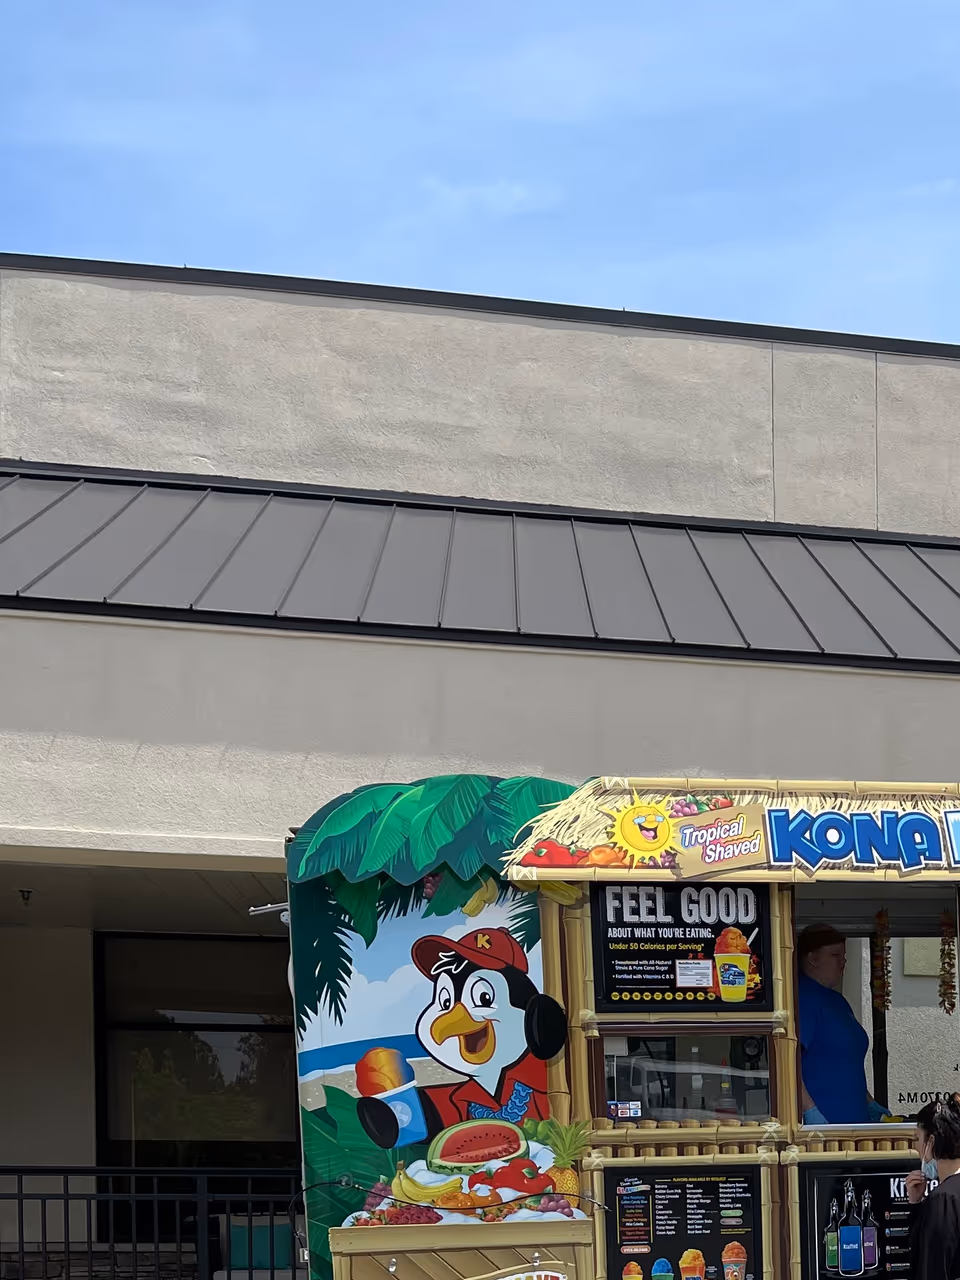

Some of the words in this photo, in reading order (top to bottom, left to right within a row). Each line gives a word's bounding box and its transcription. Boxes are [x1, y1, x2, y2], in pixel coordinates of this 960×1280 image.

[682, 817, 744, 847] Tropical
[768, 809, 945, 870] KONA
[704, 834, 762, 864] Shaved
[606, 886, 674, 923] FEEL
[680, 887, 756, 924] GOOD
[608, 928, 632, 938] ABOUT
[634, 928, 655, 938] WHAT
[658, 928, 684, 938] YOU'RE
[686, 928, 714, 938] EATING.
